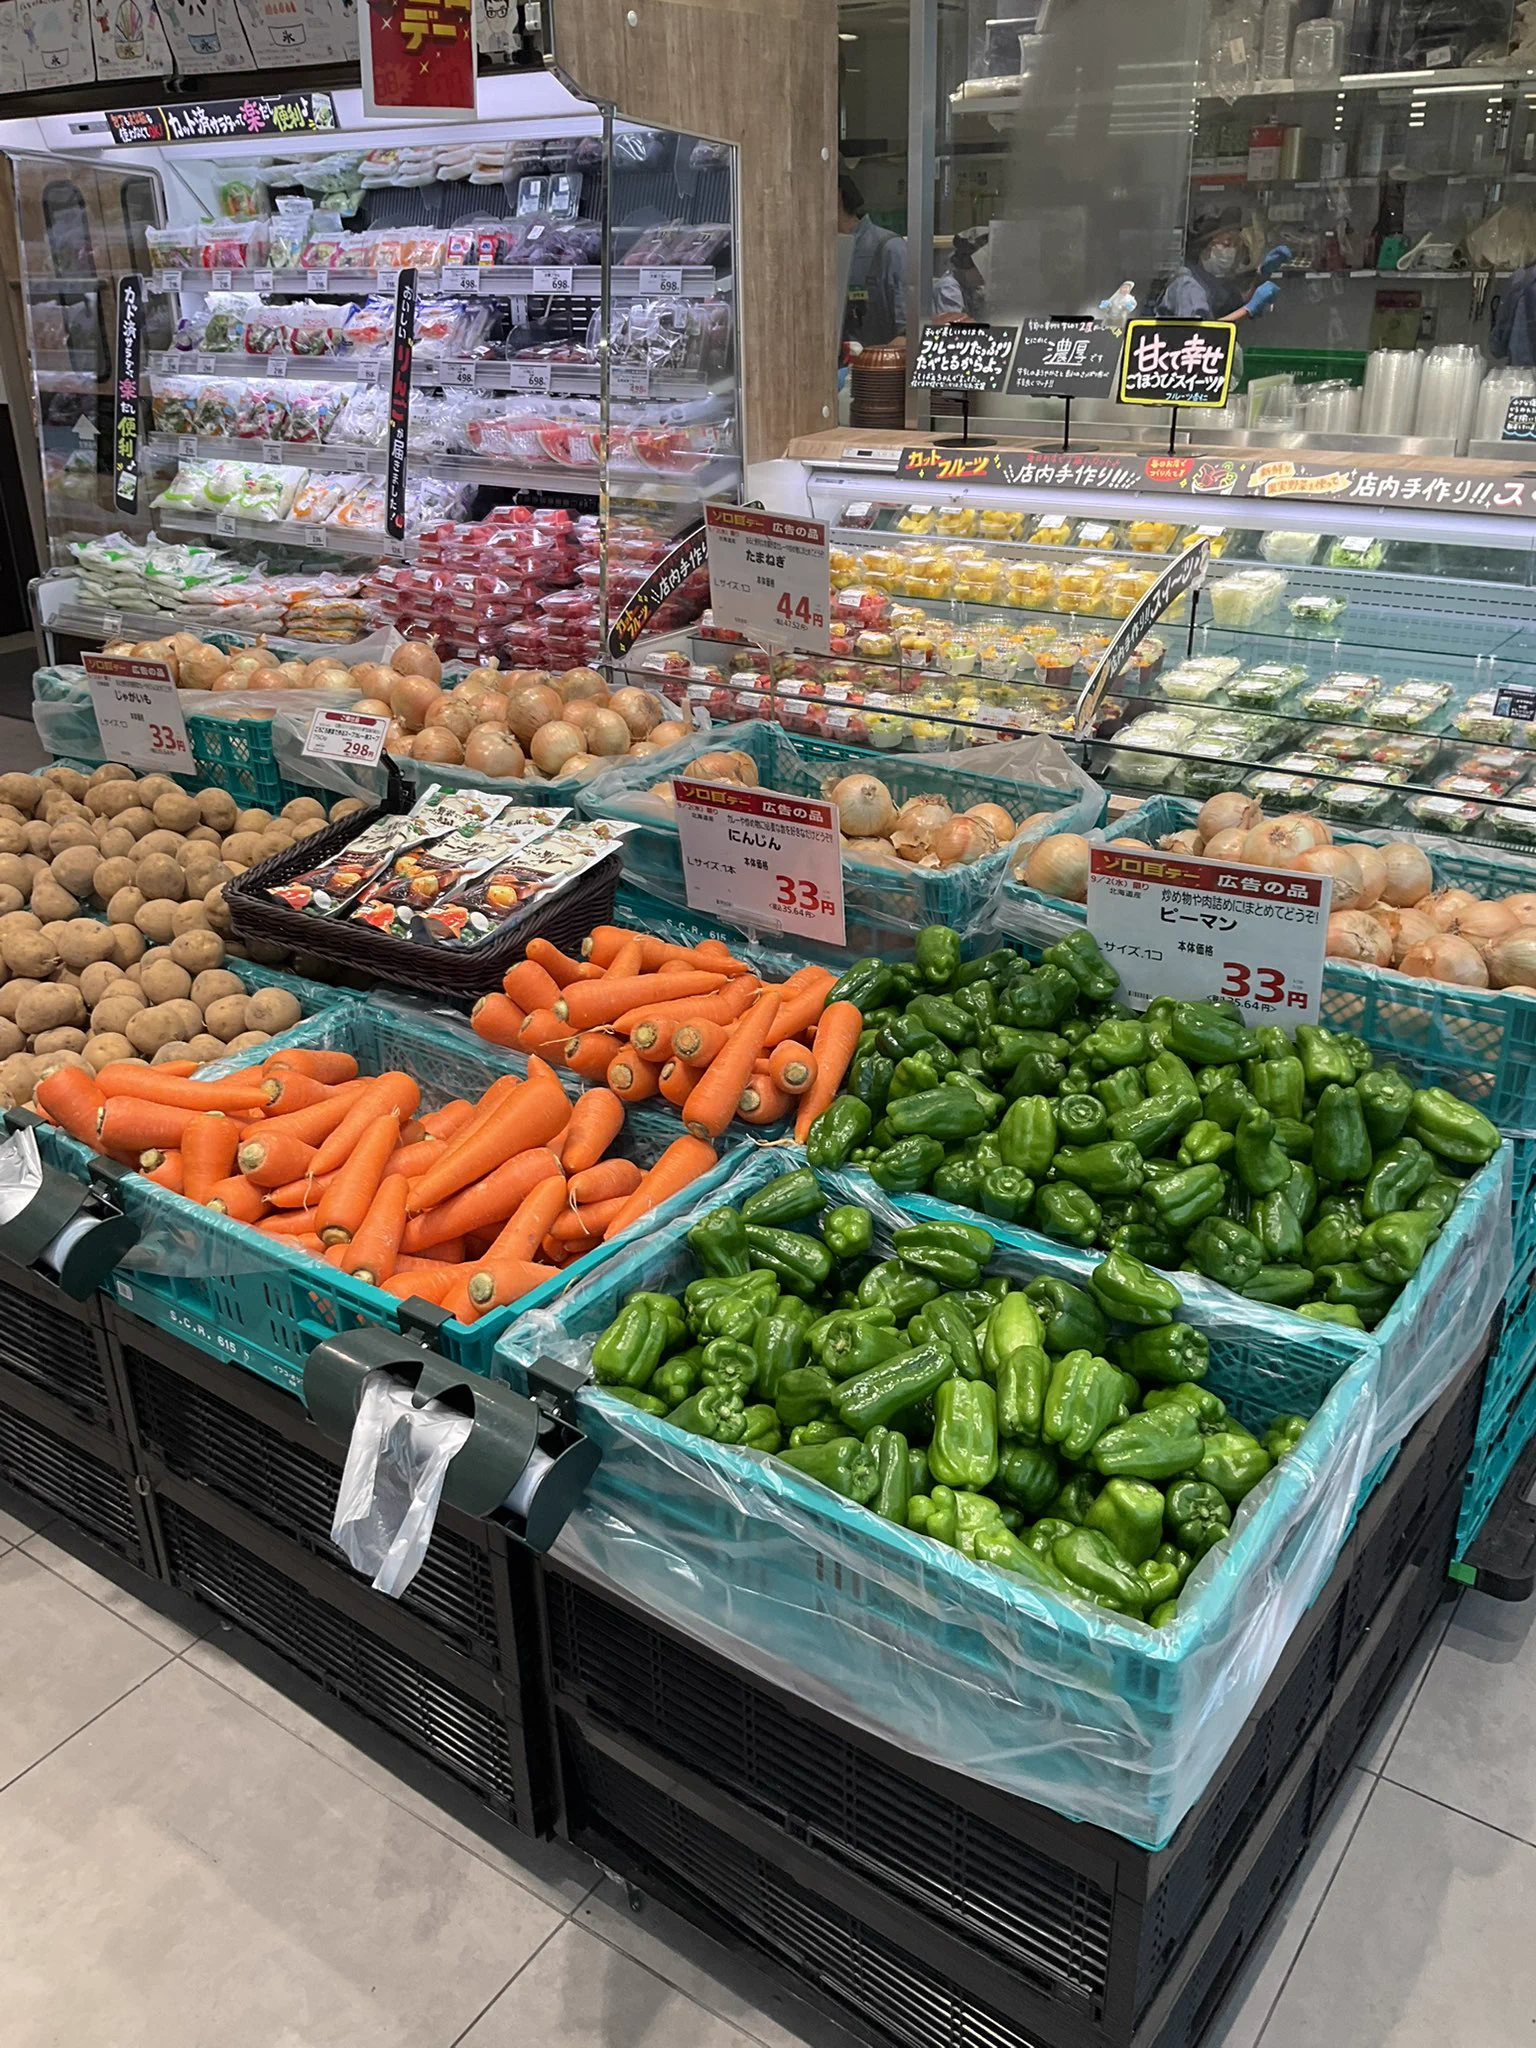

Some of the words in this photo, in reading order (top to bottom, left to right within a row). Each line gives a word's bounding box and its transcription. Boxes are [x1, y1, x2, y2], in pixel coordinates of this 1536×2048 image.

[401, 8, 456, 49] デー
[921, 341, 1012, 358] フルーツたっぷり
[1042, 337, 1091, 363] 濃厚
[1133, 333, 1225, 374] 甘くて幸せ
[1349, 472, 1494, 504] 店内手作り!!
[1493, 482, 1536, 506] ス
[772, 521, 819, 540] 広告の品
[745, 549, 786, 568] たまねぎ
[777, 591, 824, 628] 44円
[114, 689, 152, 705] じゃがいも
[762, 801, 824, 823] 広告の品
[728, 828, 782, 851] にんじん
[775, 874, 836, 916] 33円
[1109, 887, 1142, 899] 北海道産
[1132, 880, 1150, 891] 限り
[1217, 873, 1309, 901] 広告の品
[1159, 906, 1238, 931] ピーマン
[709, 931, 727, 941] 615
[1098, 940, 1164, 961] サイズ.1コ
[1177, 940, 1215, 958] 本体価格
[1220, 961, 1308, 1010] 33円
[169, 1309, 211, 1341] S.C.R.
[216, 1335, 237, 1354] 615
